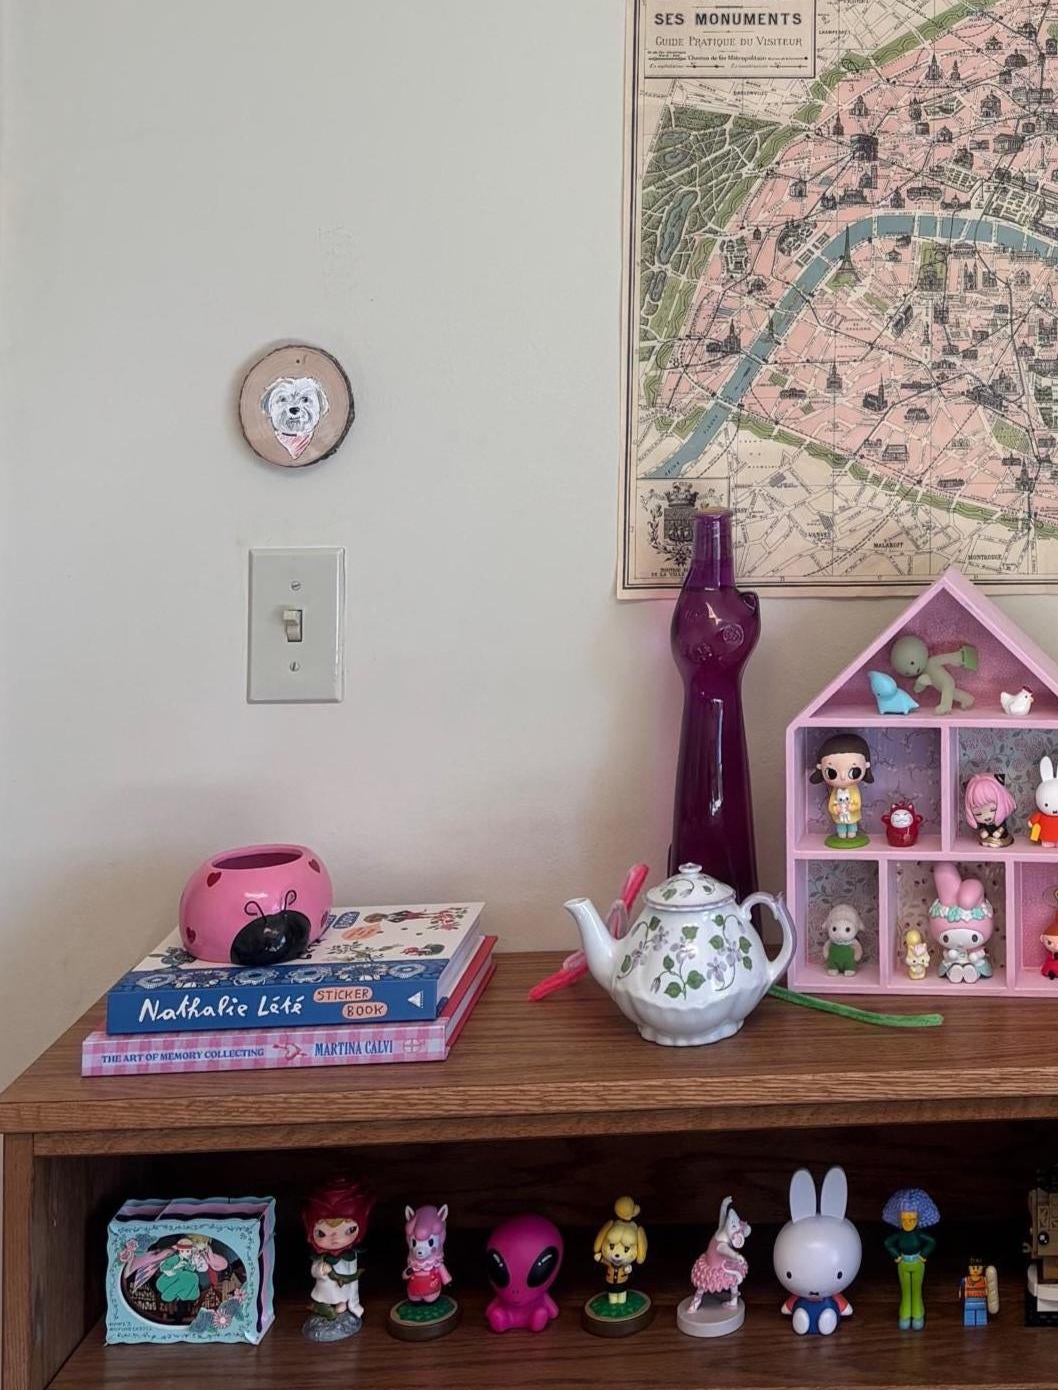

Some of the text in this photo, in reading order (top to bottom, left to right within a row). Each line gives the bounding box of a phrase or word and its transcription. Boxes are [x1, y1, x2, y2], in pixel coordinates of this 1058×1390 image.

[654, 13, 685, 26] SES
[695, 12, 802, 26] MONUMENTS
[655, 35, 803, 48] GUIDE PRATIQUE DU VISITEUR
[316, 988, 370, 1001] STICKER
[138, 994, 305, 1023] Nathalie Lété
[347, 1004, 384, 1018] BOOK
[314, 1040, 393, 1057] MARTINA CALVI
[101, 1048, 265, 1064] THE ART OF MEMORY COLLECTING
